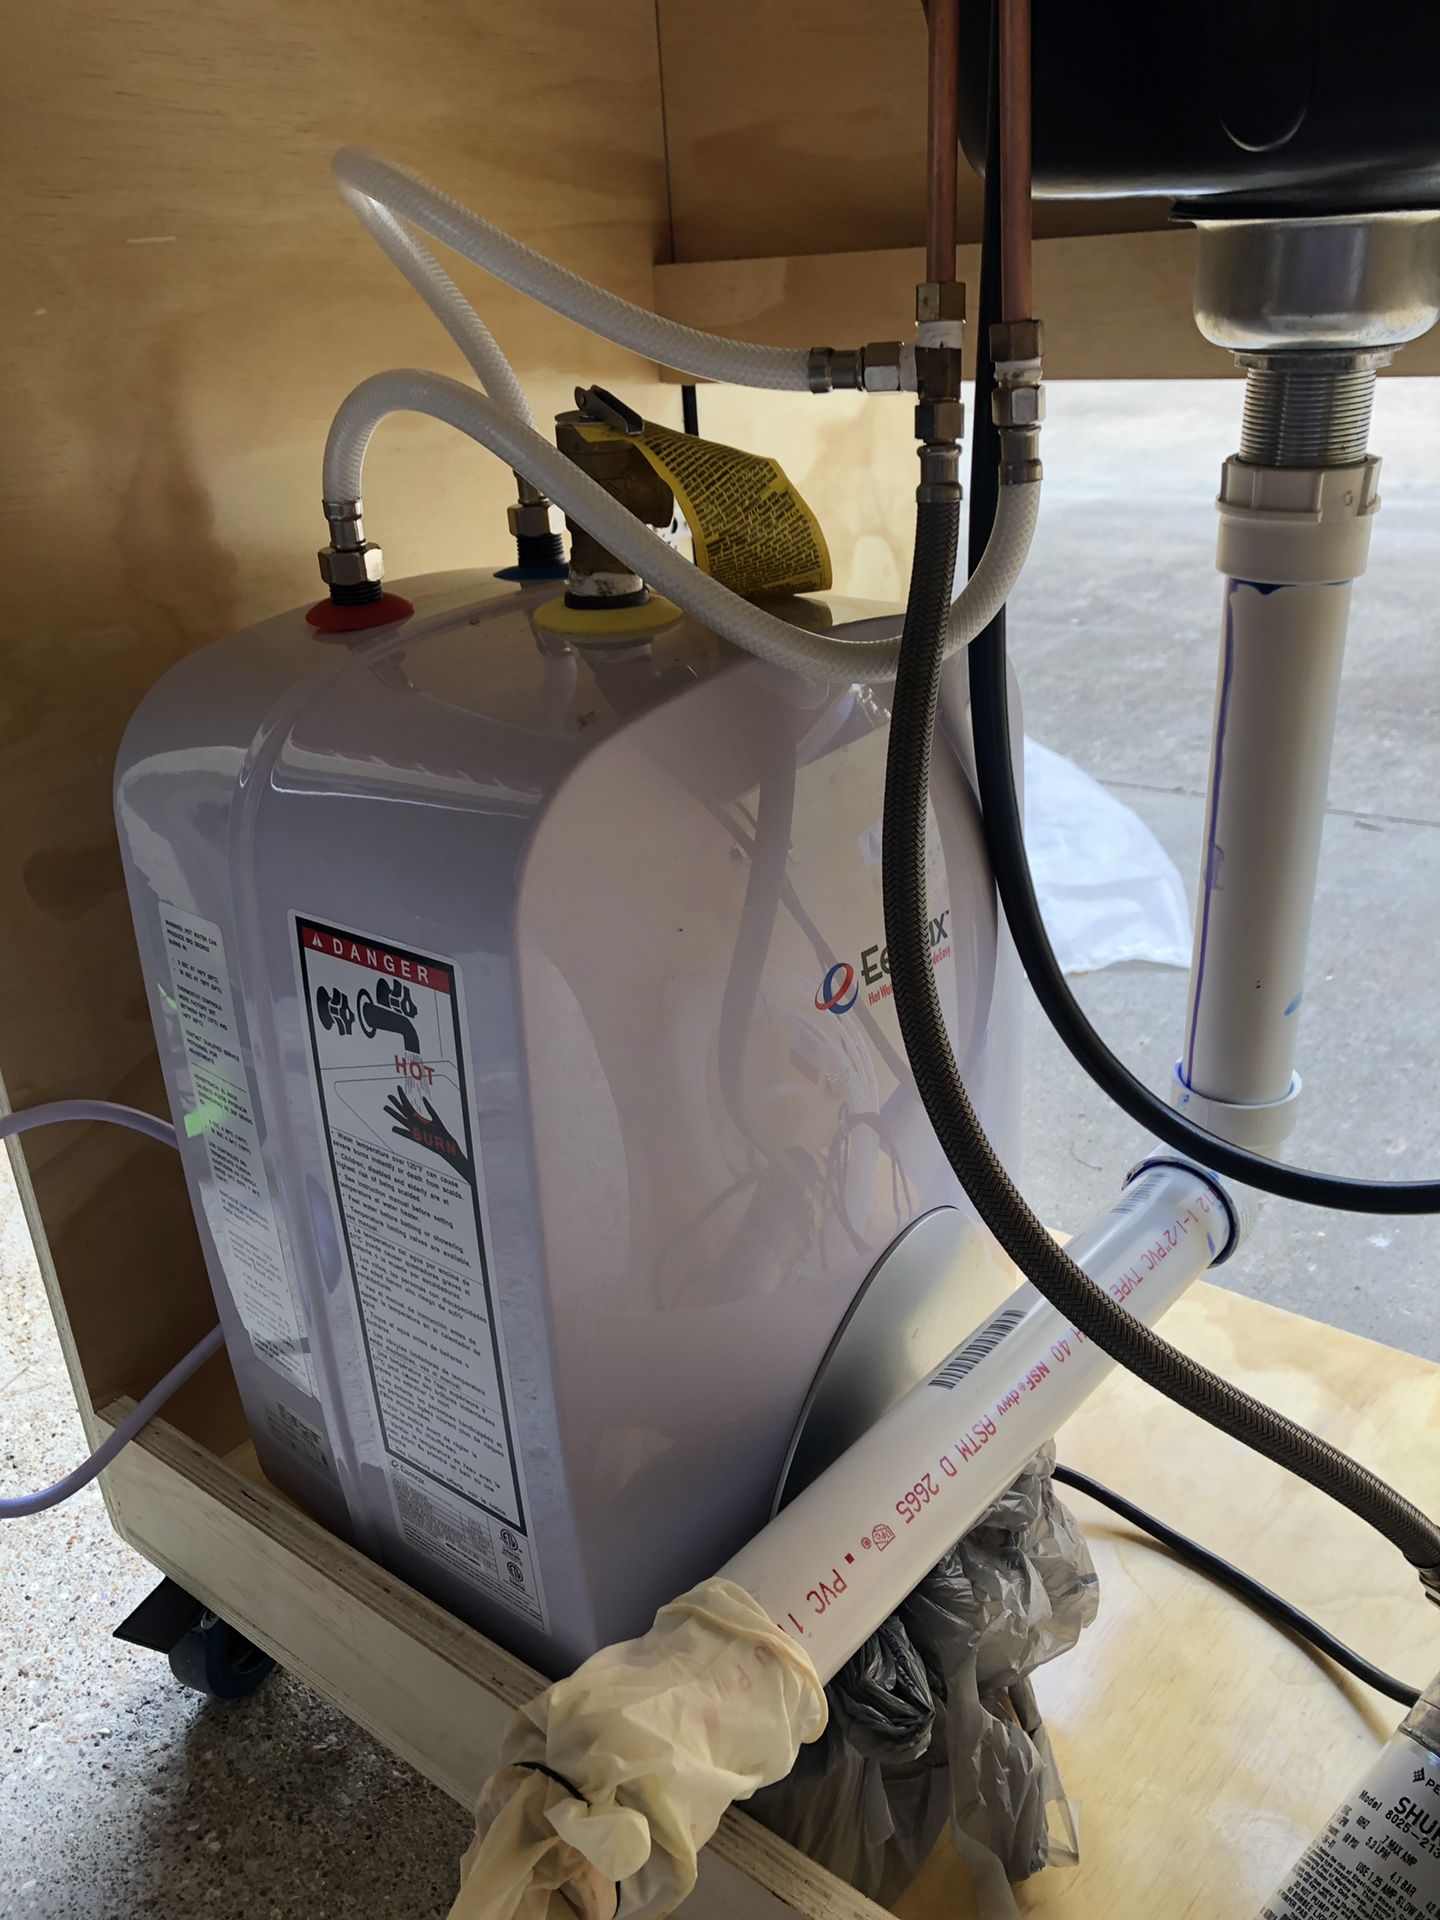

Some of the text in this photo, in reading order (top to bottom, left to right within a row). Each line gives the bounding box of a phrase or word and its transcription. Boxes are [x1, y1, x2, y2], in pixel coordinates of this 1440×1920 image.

[333, 938, 430, 983] DANGER
[868, 989, 881, 1005] Hot
[394, 1054, 435, 1085] HOT
[411, 1127, 457, 1156] BURN
[332, 1139, 350, 1151] severe
[352, 1147, 368, 1159] burns
[371, 1156, 394, 1171] instantly
[406, 1171, 423, 1182] death
[425, 1178, 439, 1189] from
[336, 1131, 353, 1143] Water
[355, 1139, 389, 1159] temperature
[391, 1156, 404, 1165] over
[426, 1170, 437, 1179] can
[439, 1176, 458, 1188] cause
[336, 1159, 355, 1173] highest
[357, 1170, 368, 1178] risk
[378, 1178, 395, 1192] being
[339, 1180, 371, 1200] temperature
[382, 1201, 397, 1211] water
[367, 1165, 391, 1180] disabled
[393, 1177, 404, 1186] and
[407, 1183, 427, 1196] elderly
[430, 1192, 440, 1201] are
[344, 1173, 453, 1229] See instruction manual before setting
[345, 1213, 355, 1221] see
[347, 1194, 359, 1204] Feel
[362, 1202, 377, 1212] water
[379, 1209, 397, 1222] before
[399, 1218, 421, 1234] bathing
[349, 1205, 384, 1226] Temperature
[409, 1235, 427, 1247] valves
[430, 1244, 440, 1252] are
[1113, 1270, 1144, 1303] TYPE
[1053, 1340, 1072, 1364] 40
[957, 1419, 997, 1462] ASTM
[939, 1455, 958, 1478] D
[895, 1472, 940, 1524] 2665
[804, 1568, 848, 1614] PVC
[1358, 1790, 1382, 1811] Model
[1365, 1836, 1391, 1861] 5.3 LPM
[1386, 1839, 1403, 1856] MAX
[1399, 1850, 1417, 1866] AMP
[1336, 1862, 1346, 1871] risk
[1351, 1873, 1378, 1897] Electrical
[1347, 1836, 1359, 1849] PSI
[1389, 1871, 1402, 1884] 4.1
[1399, 1879, 1416, 1898] BAR
[1299, 1885, 1311, 1897] NOT
[1309, 1894, 1329, 1912] PUMP
[1327, 1879, 1337, 1890] Use
[1337, 1887, 1349, 1900] Only
[1333, 1876, 1351, 1893] Marine
[1355, 1861, 1418, 1916] USE 1.25 AMP SLOW
[1295, 1905, 1308, 1918] PAS
[1361, 1889, 1374, 1903] This
[1373, 1902, 1391, 1918] pump
